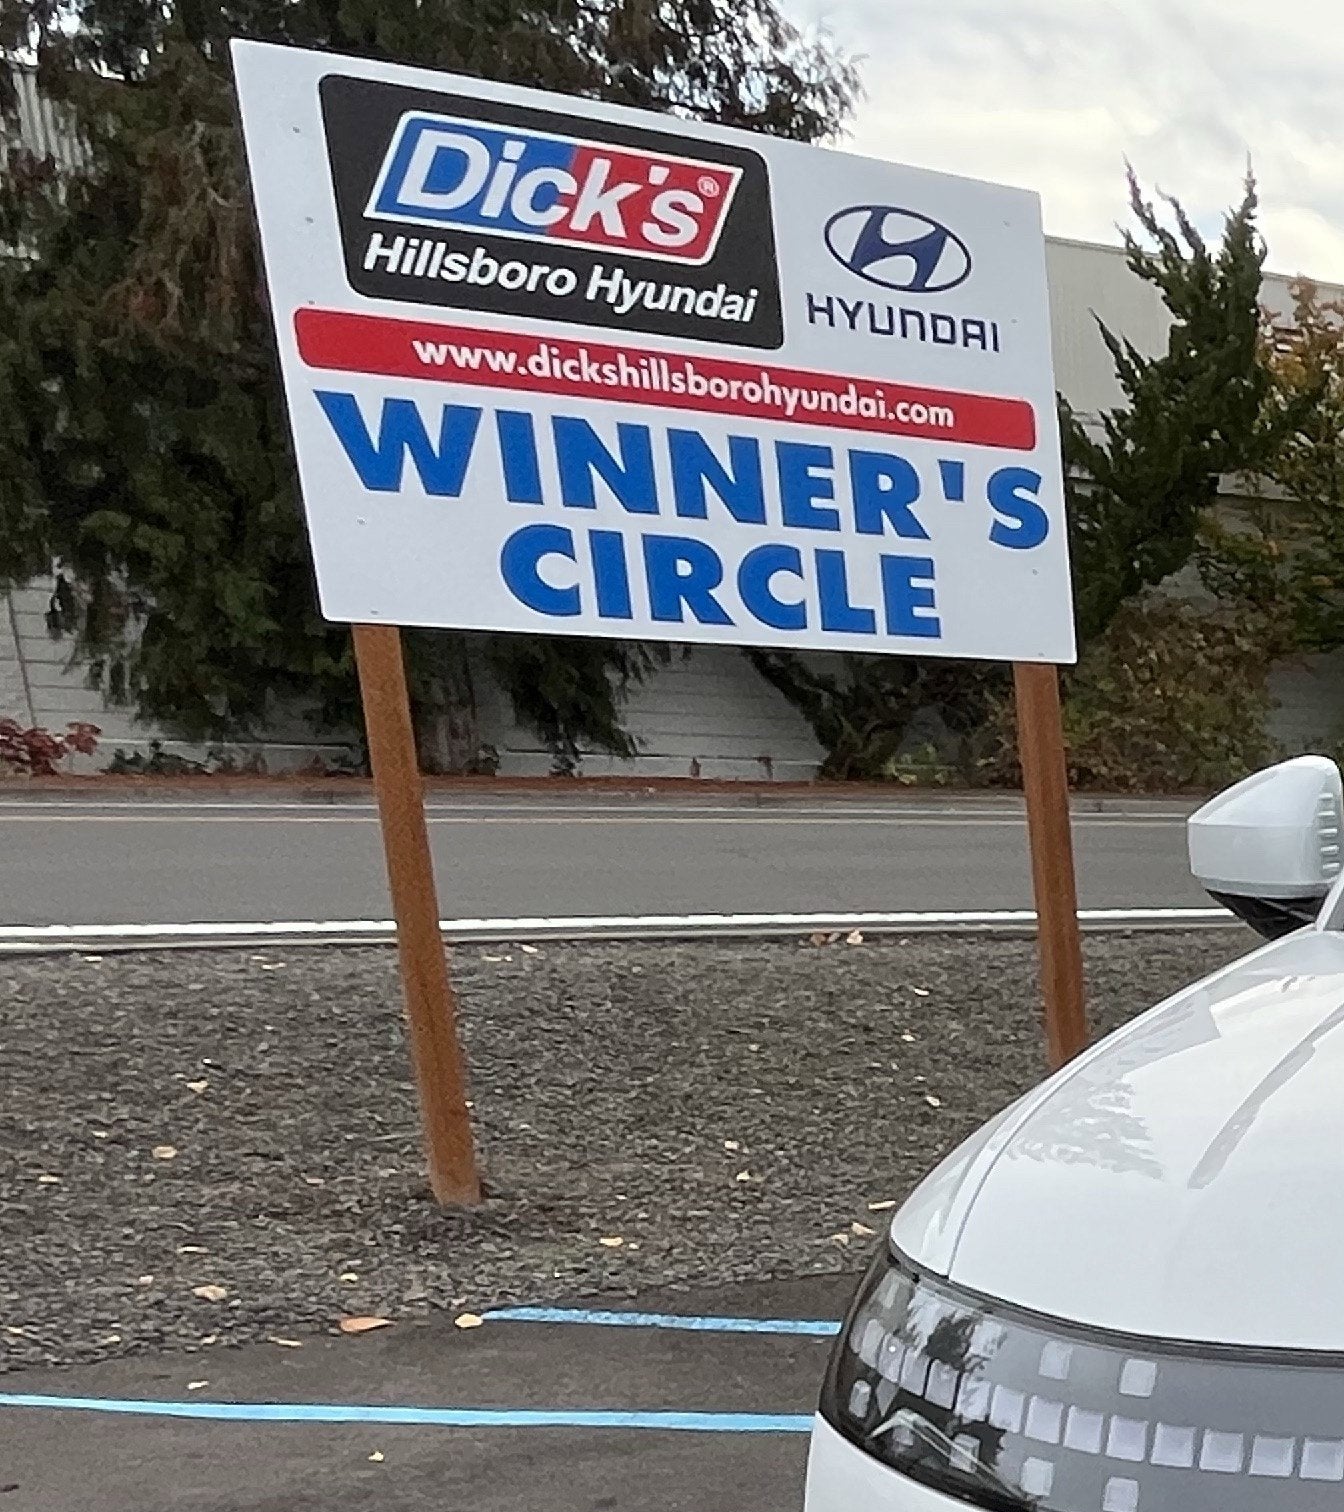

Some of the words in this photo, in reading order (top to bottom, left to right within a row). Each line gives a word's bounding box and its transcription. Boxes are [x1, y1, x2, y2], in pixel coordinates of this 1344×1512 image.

[363, 233, 578, 298] Hillsboro
[584, 266, 760, 325] Hyundai
[805, 293, 1001, 354] HYUNDAI
[411, 336, 955, 431] www.dickshillsborohyundai.com
[313, 388, 1051, 551] WINNER'S
[499, 523, 943, 641] CIRCLE
